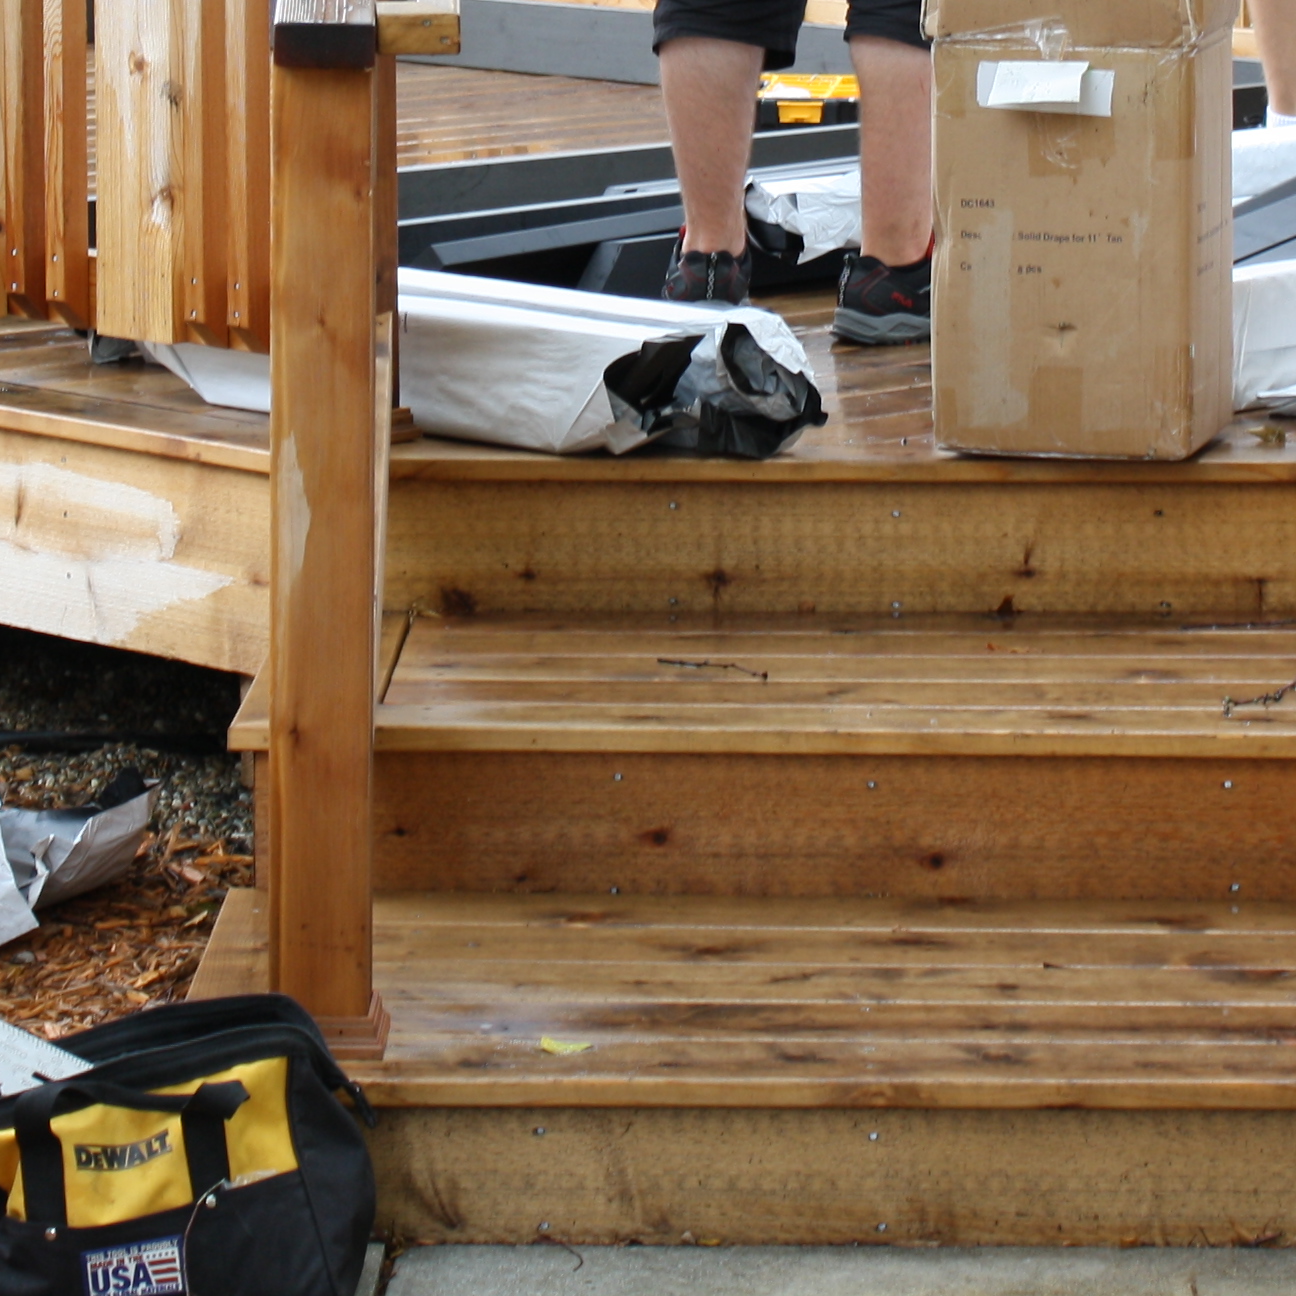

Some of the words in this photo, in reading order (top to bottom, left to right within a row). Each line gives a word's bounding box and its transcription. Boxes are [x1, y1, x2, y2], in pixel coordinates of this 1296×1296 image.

[1017, 231, 1041, 242] Solid
[1043, 232, 1070, 244] Drape
[1072, 233, 1085, 243] for
[1107, 234, 1123, 244] Tan
[1025, 264, 1042, 275] pcs
[91, 1261, 154, 1295] USA
